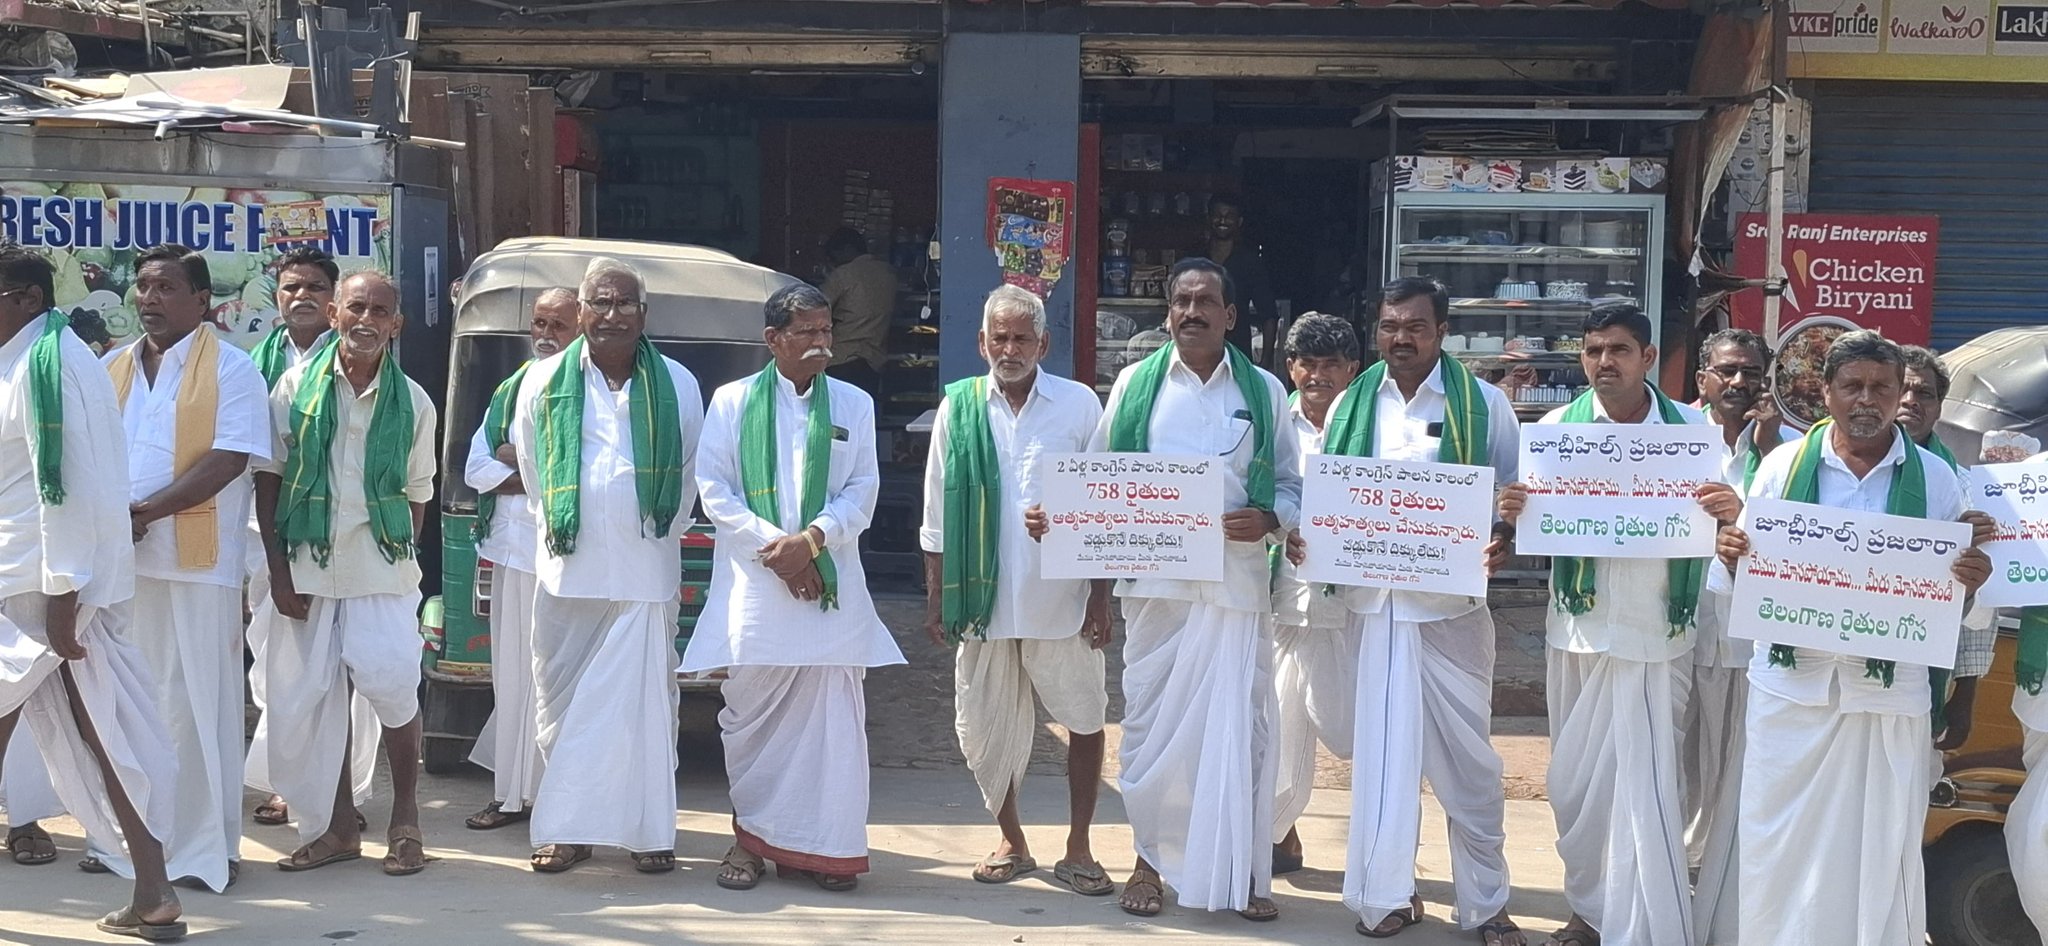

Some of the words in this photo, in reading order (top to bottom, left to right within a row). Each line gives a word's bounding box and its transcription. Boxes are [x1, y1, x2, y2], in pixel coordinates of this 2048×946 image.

[1788, 16, 1829, 33] VKC
[1834, 12, 1878, 37] pride
[113, 200, 234, 252] JUICE
[246, 203, 377, 256] PNT
[1786, 223, 1828, 244] Ranj
[1830, 225, 1928, 245] Enterprises
[1809, 258, 1925, 284] Chicken
[1815, 285, 1914, 315] Biryani
[1529, 433, 1623, 463] జూబ్లీహిల్స్
[1629, 438, 1710, 462] ప్రజలారా
[1057, 461, 1065, 473] 2
[1069, 458, 1088, 478] ఏళ్ల
[1091, 458, 1127, 477] కాంగ్రెస్
[1131, 461, 1165, 474] పాలన
[1168, 460, 1209, 475] కాలంలో
[1319, 463, 1328, 475] 2
[1332, 461, 1352, 482] ఏళ్ల
[1355, 464, 1393, 483] కాంగ్రెస్
[1397, 467, 1431, 483] పాలన
[1435, 471, 1479, 486] కాలంలో
[1086, 482, 1120, 499] 758
[1125, 481, 1180, 507] రైతులు
[1349, 487, 1384, 507] 758
[1389, 489, 1447, 516] రైతులు
[1052, 511, 1128, 531] ఆత్మహత్యలు
[1311, 513, 1391, 538] ఆత్మహత్యలు
[1540, 513, 1609, 536] తెలంగాణ
[1614, 514, 1658, 545] రైతుల
[1664, 513, 1691, 537] గోస
[1755, 513, 1860, 551] జూబ్లీహిల్స్
[1866, 528, 1958, 555] ప్రజలారా
[1748, 553, 1777, 578] మేము
[1865, 567, 1890, 594] మీరు
[1893, 575, 1953, 602] మోసపోకండి
[1758, 596, 1834, 629] తెలంగాణ
[1840, 609, 1890, 642] రైతుల
[1896, 612, 1927, 642] గోస
